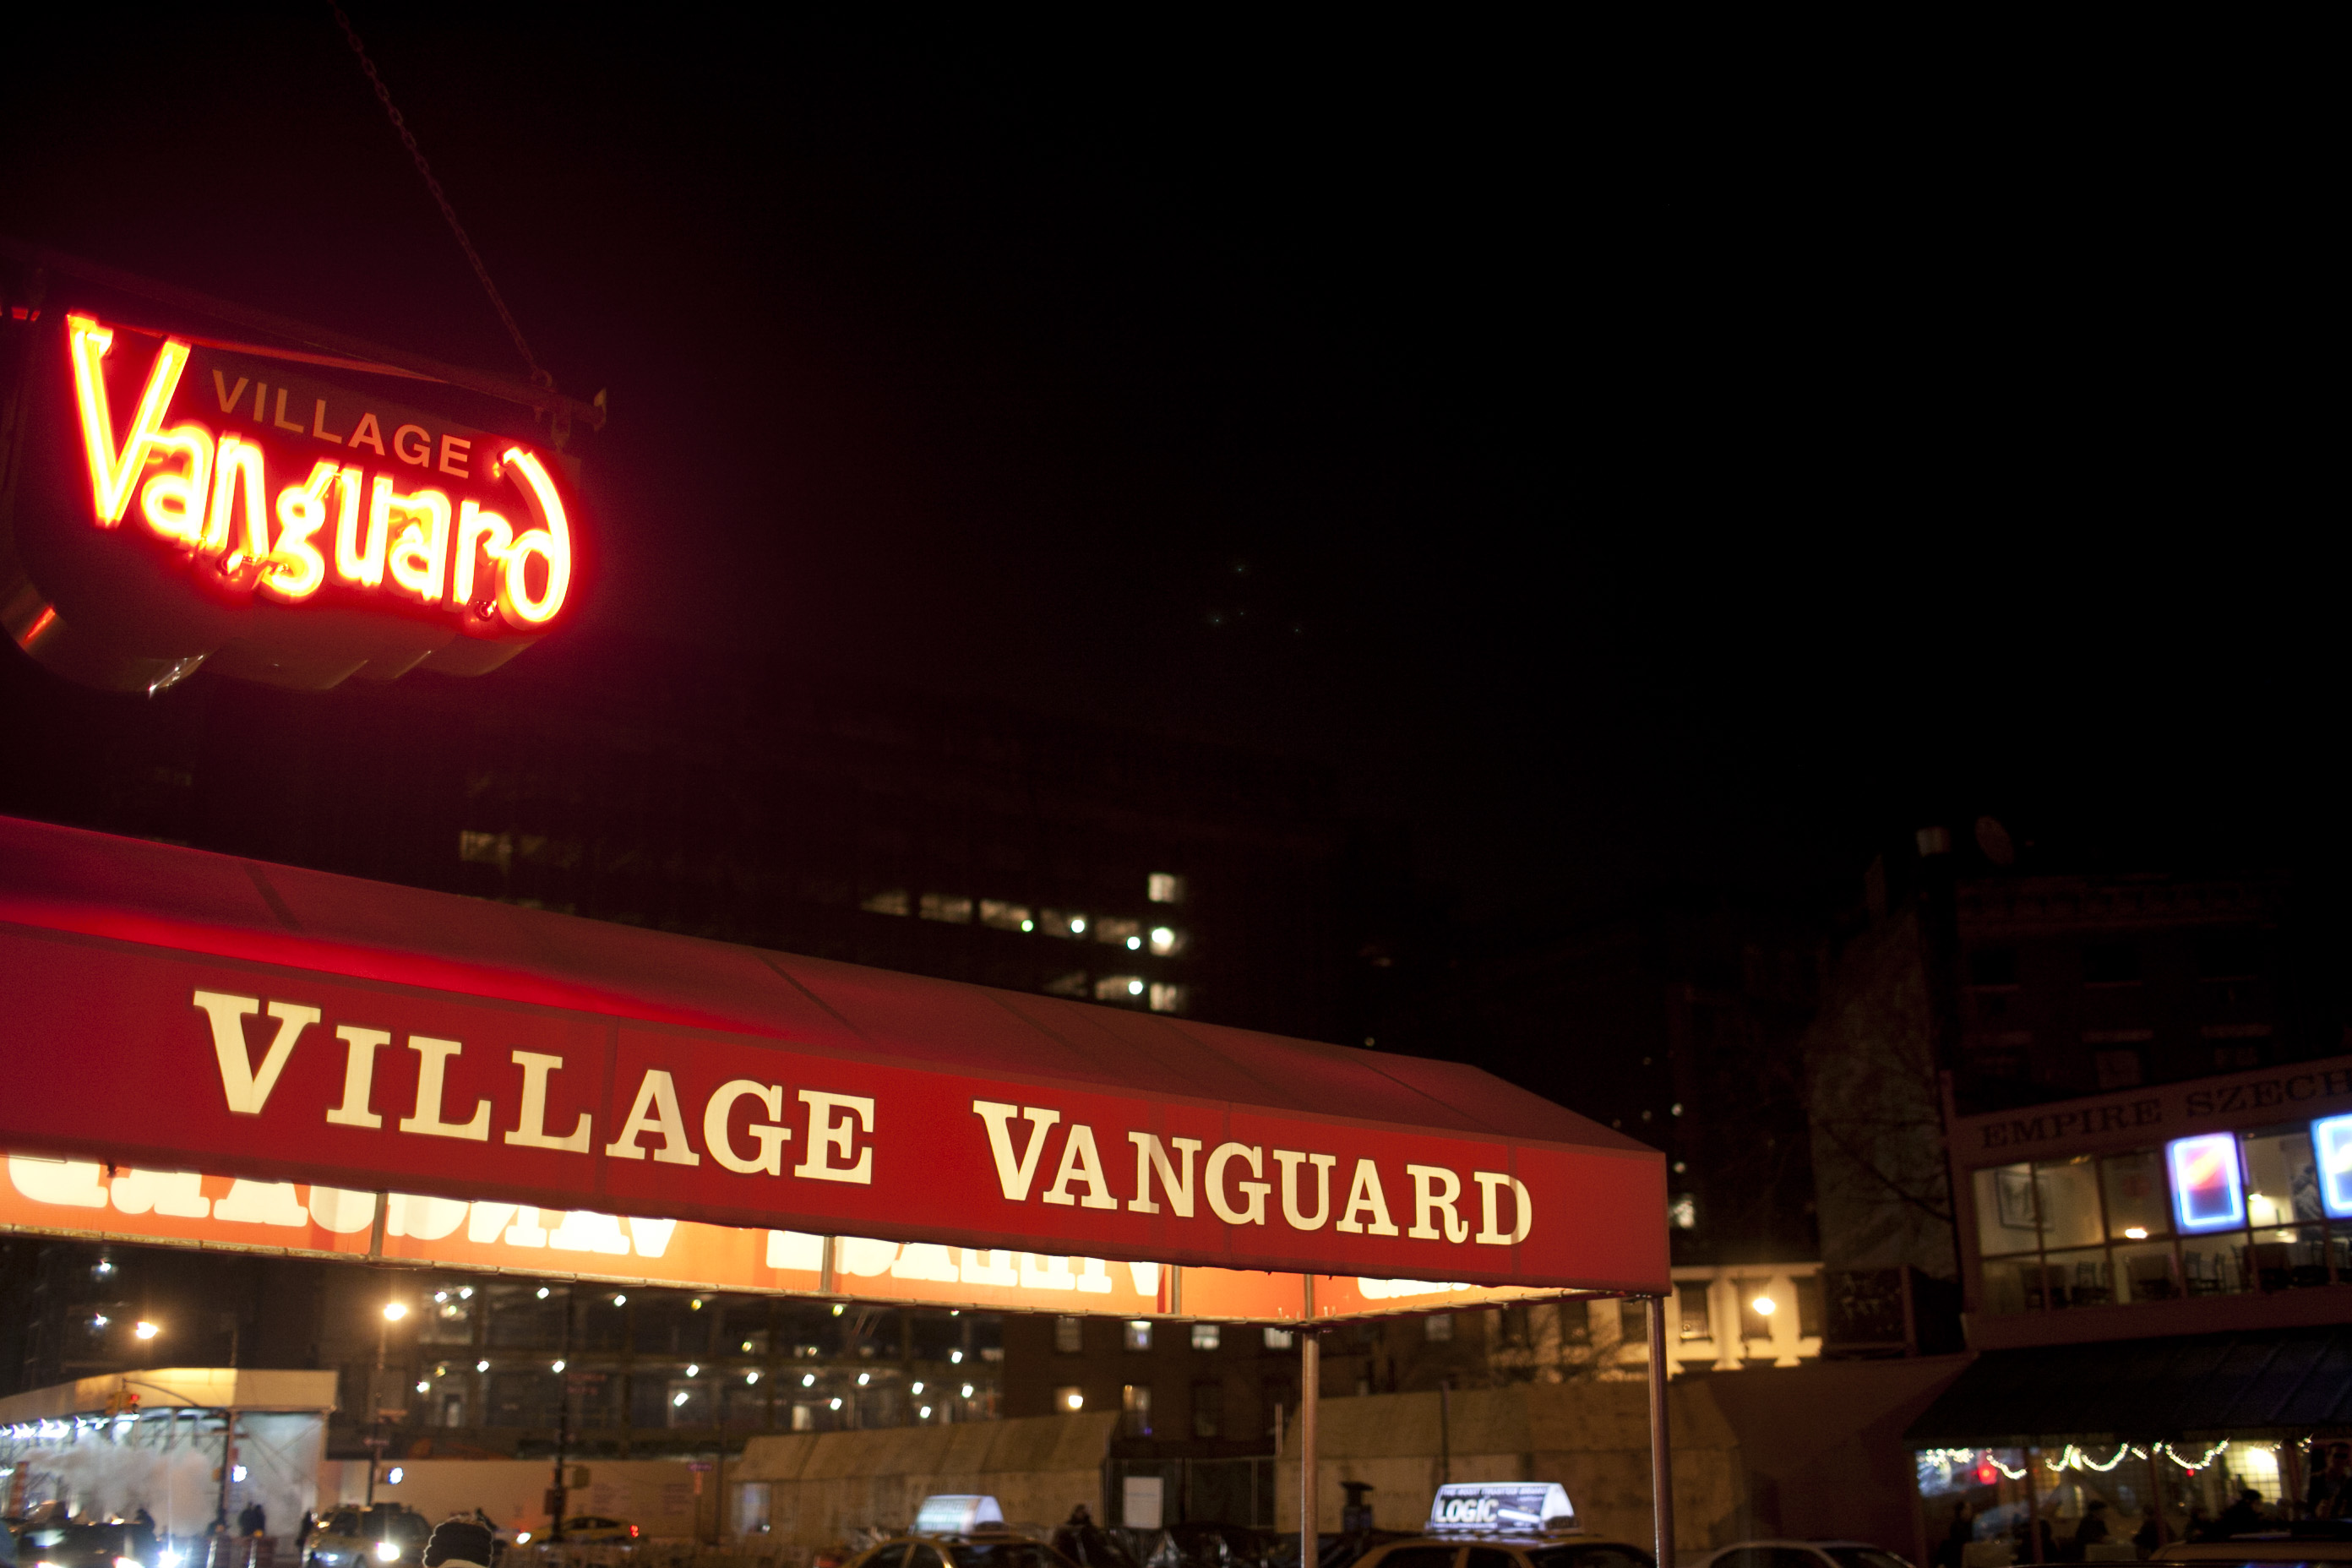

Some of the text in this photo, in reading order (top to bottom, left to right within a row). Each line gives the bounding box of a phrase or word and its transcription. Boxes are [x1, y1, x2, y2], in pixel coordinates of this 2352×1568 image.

[67, 313, 572, 625] Vanguard
[211, 369, 471, 478] VILLAGE
[193, 990, 1533, 1245] VILLAGE VANGUARD
[1980, 1099, 2163, 1150] EMPIRE
[1435, 1498, 1499, 1523] LOGIC
